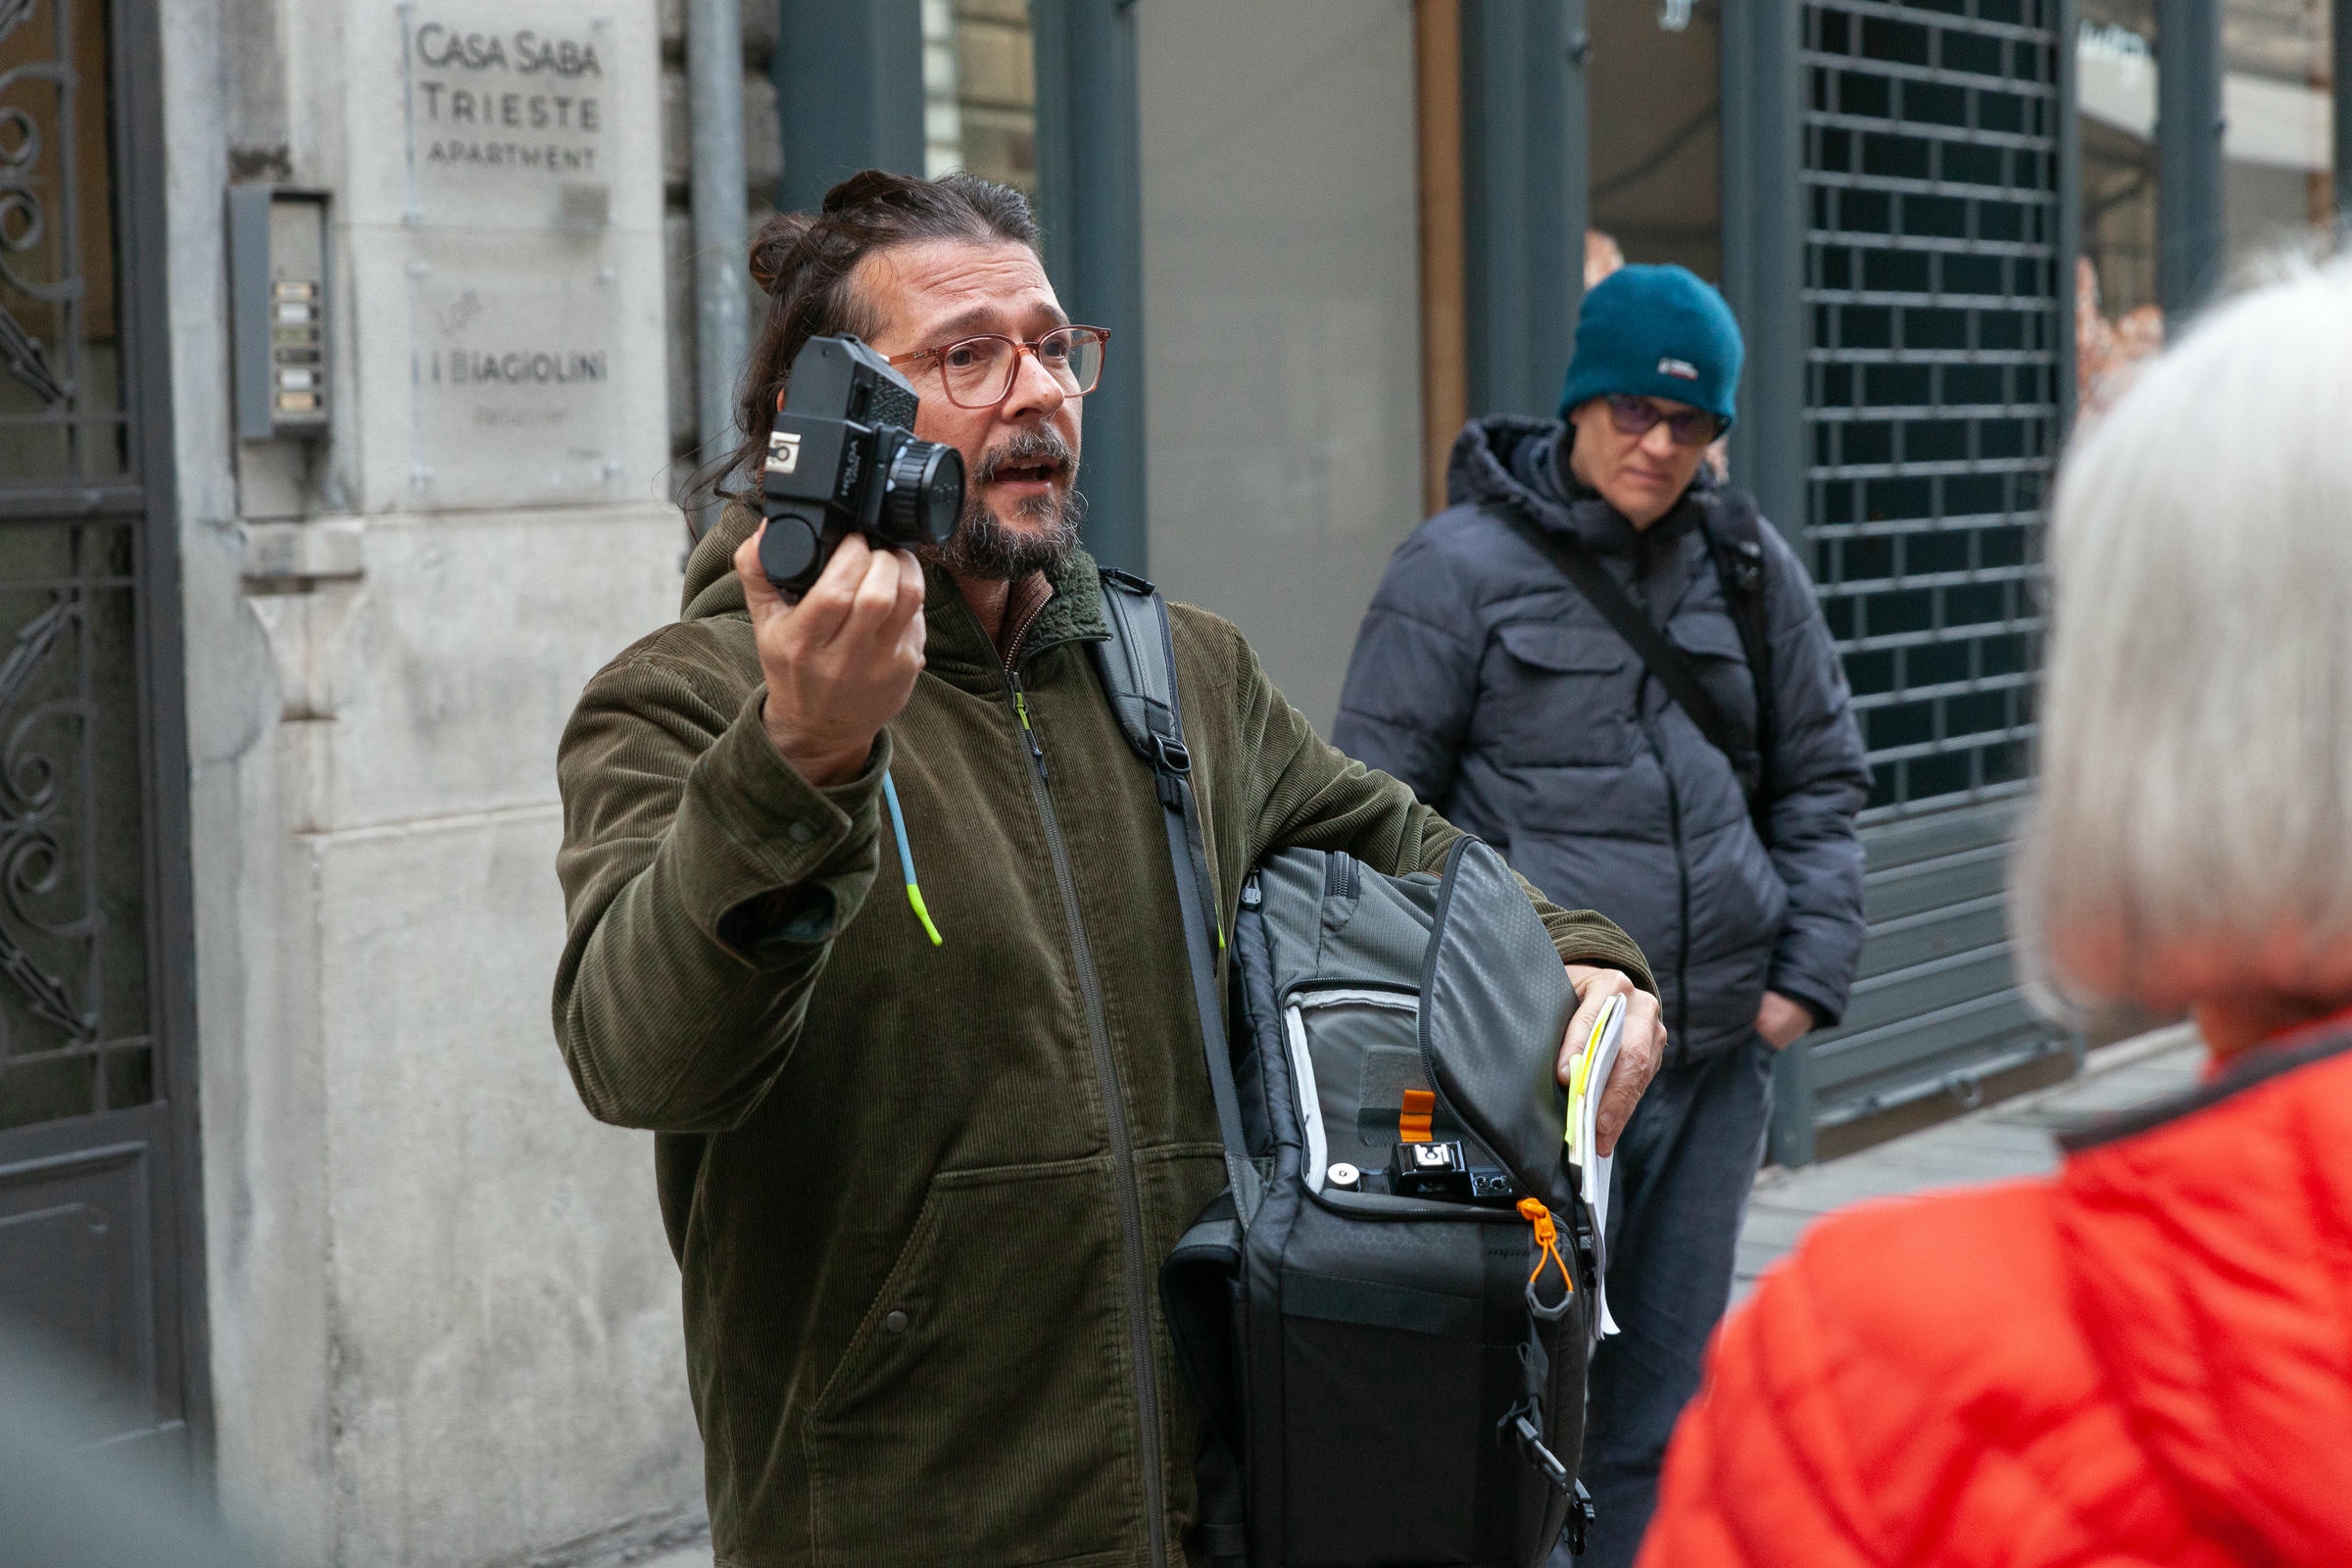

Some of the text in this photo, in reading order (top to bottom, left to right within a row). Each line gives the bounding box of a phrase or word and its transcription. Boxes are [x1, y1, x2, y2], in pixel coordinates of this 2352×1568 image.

[416, 22, 603, 78] CASA SABA
[420, 80, 600, 133] TRIESTE
[427, 140, 596, 172] APARTMENT
